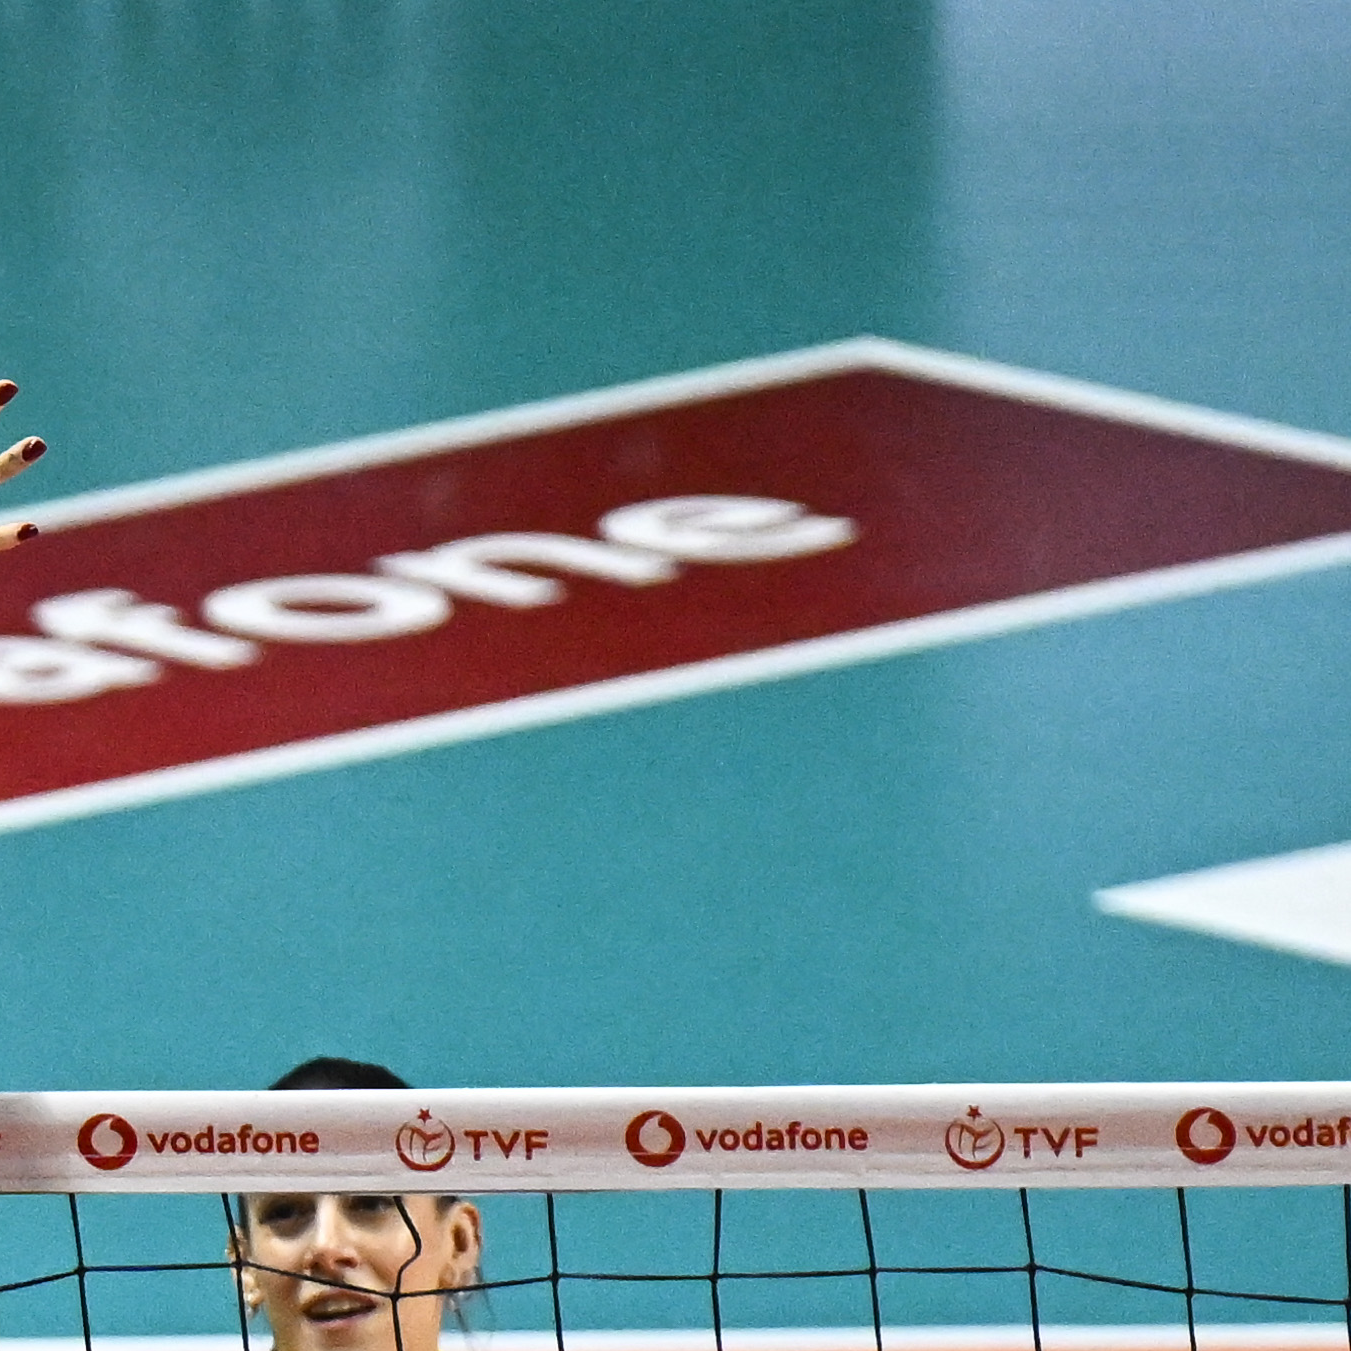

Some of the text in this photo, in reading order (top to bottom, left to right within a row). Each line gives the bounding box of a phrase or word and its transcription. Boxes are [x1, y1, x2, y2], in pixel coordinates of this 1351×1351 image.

[147, 1114, 321, 1155] vodafone
[463, 1129, 550, 1161] TVF
[696, 1120, 869, 1152] vodafone
[1013, 1126, 1099, 1158] TVF
[1245, 1117, 1351, 1148] vodaf
